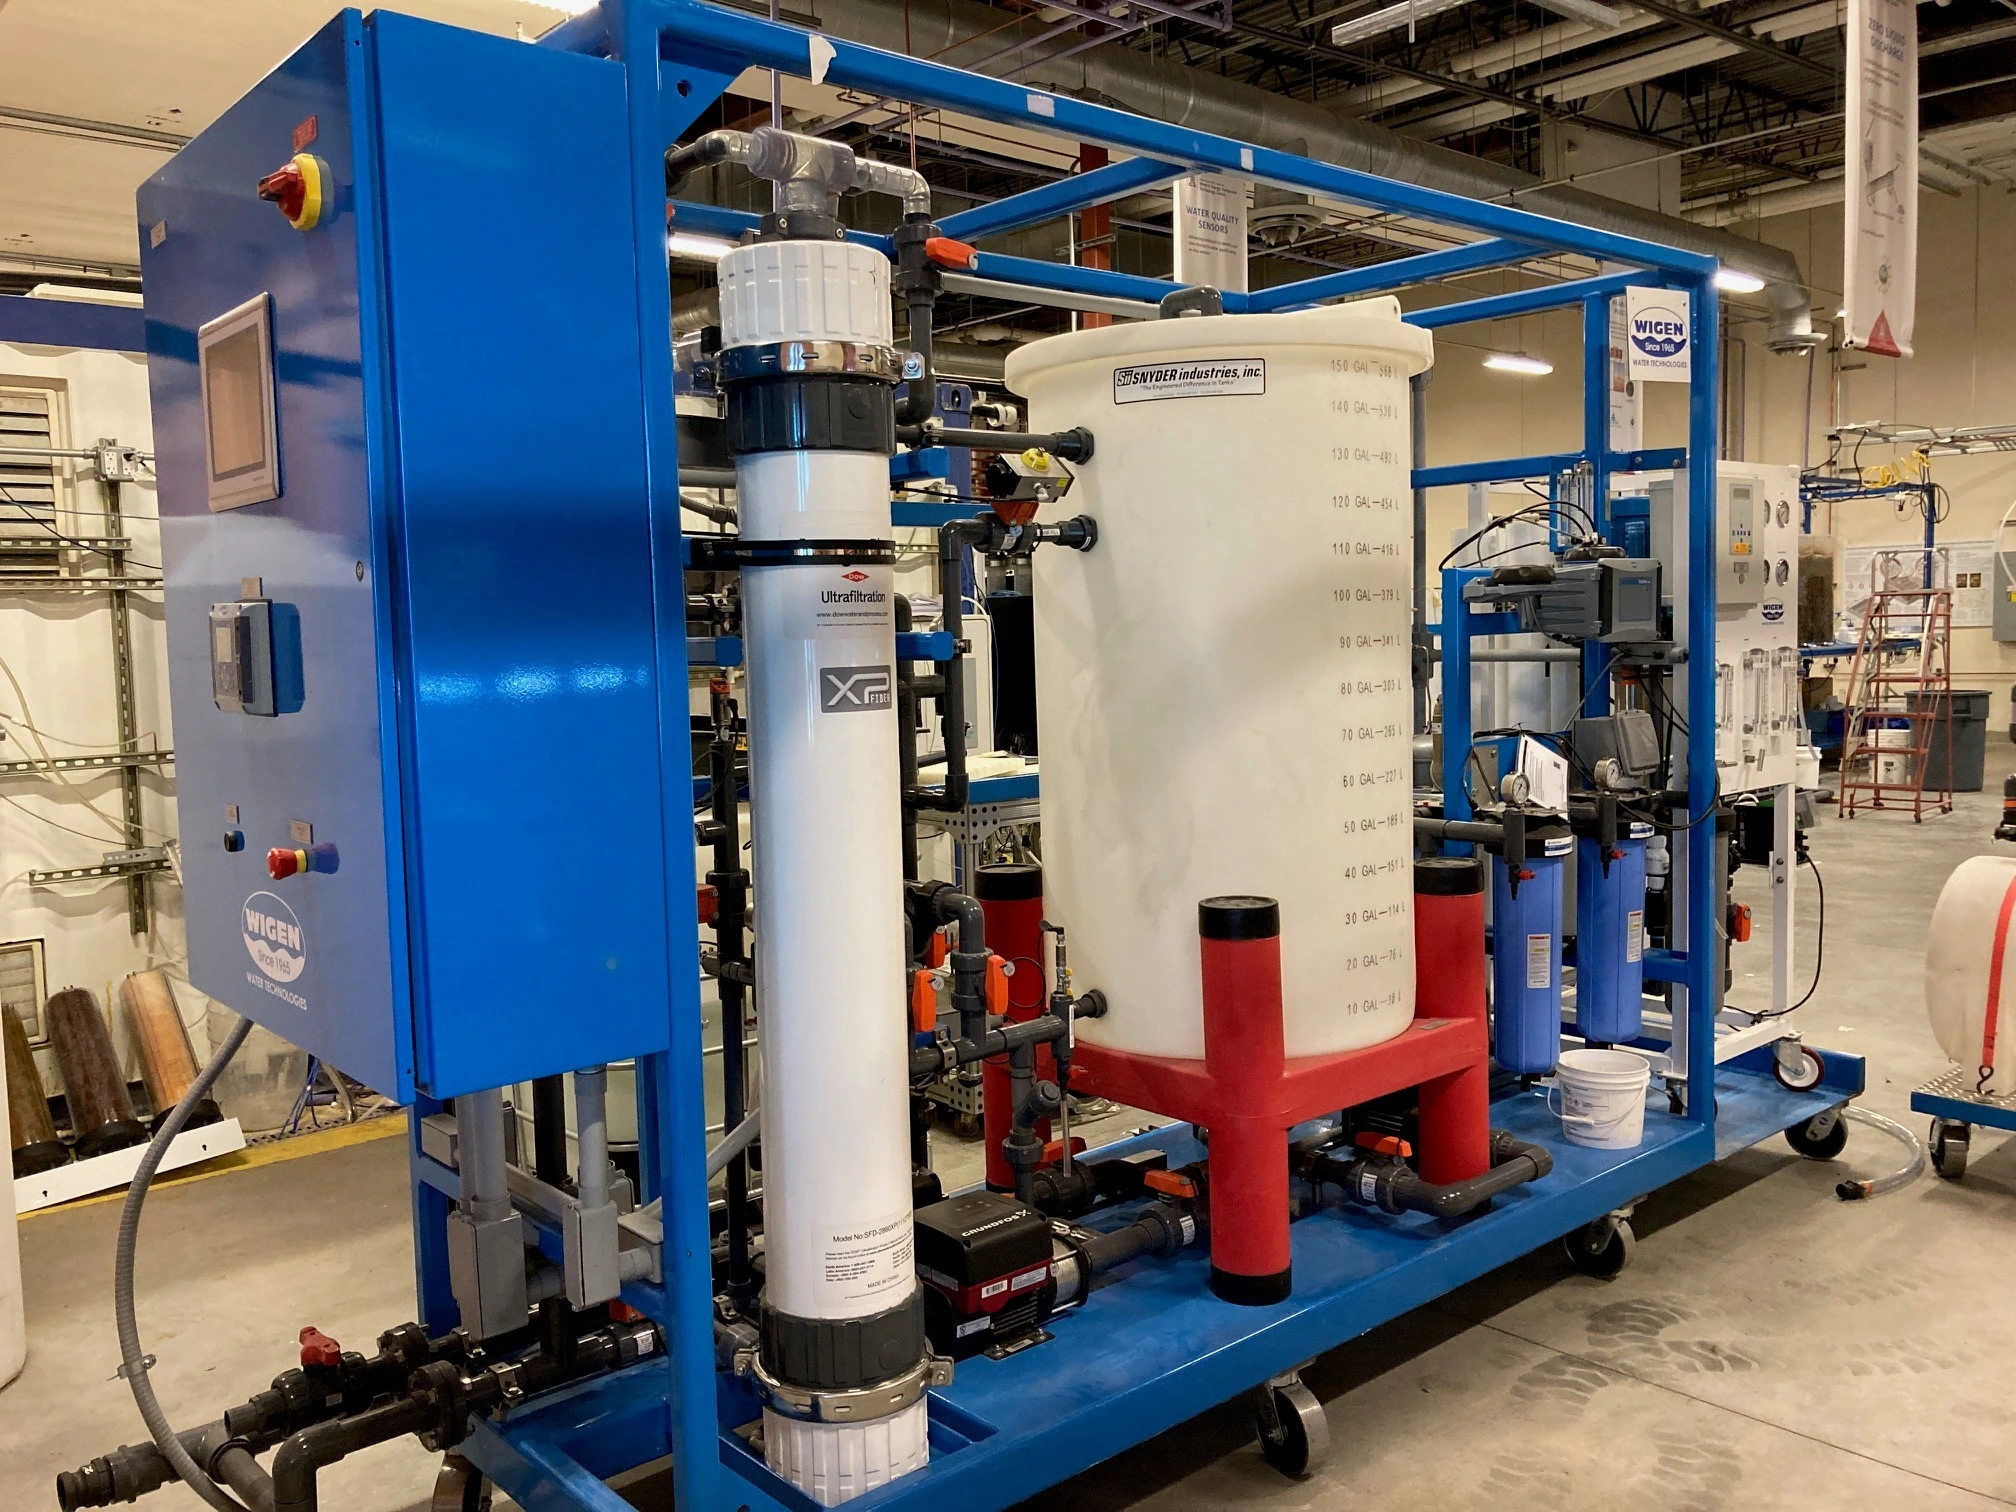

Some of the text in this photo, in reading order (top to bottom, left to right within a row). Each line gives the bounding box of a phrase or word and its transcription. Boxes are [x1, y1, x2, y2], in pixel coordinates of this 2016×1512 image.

[1186, 205, 1239, 225] WATER QUALITY
[1198, 220, 1229, 235] SENSORS
[1634, 319, 1684, 336] WIGEN
[1645, 342, 1675, 353] Since 1965
[1331, 359, 1349, 372] 150
[1632, 359, 1688, 369] WATER TECHNOLOGIES
[1132, 369, 1178, 385] SNYDER
[1178, 366, 1240, 381] industries,
[1243, 365, 1263, 378] inc.
[1152, 381, 1183, 391] Engineered
[1182, 380, 1211, 389] Difference
[1332, 400, 1349, 413] 140
[1332, 447, 1349, 460] 130
[1333, 495, 1350, 508] 120
[1333, 542, 1350, 555] 110
[821, 590, 886, 603] Ultrafiltration
[1333, 589, 1351, 602] 100
[1340, 636, 1351, 649] 90
[1341, 682, 1352, 695] 80
[870, 693, 890, 704] FIBER
[1342, 728, 1353, 741] 70
[1343, 774, 1355, 788] 60
[1344, 820, 1356, 834] 50
[1345, 866, 1356, 880] 40
[1345, 911, 1357, 925] 30
[245, 907, 301, 951] WIGEN
[258, 949, 291, 975] Since 1965
[1346, 957, 1358, 971] 20
[246, 971, 308, 1011] WATER TECHNOLOGIES
[1347, 1002, 1358, 1016] 10
[961, 1214, 1020, 1237] GRUNDFOS
[832, 1234, 853, 1242] Model
[867, 1281, 881, 1289] MADE
[886, 1273, 899, 1283] CHINA
